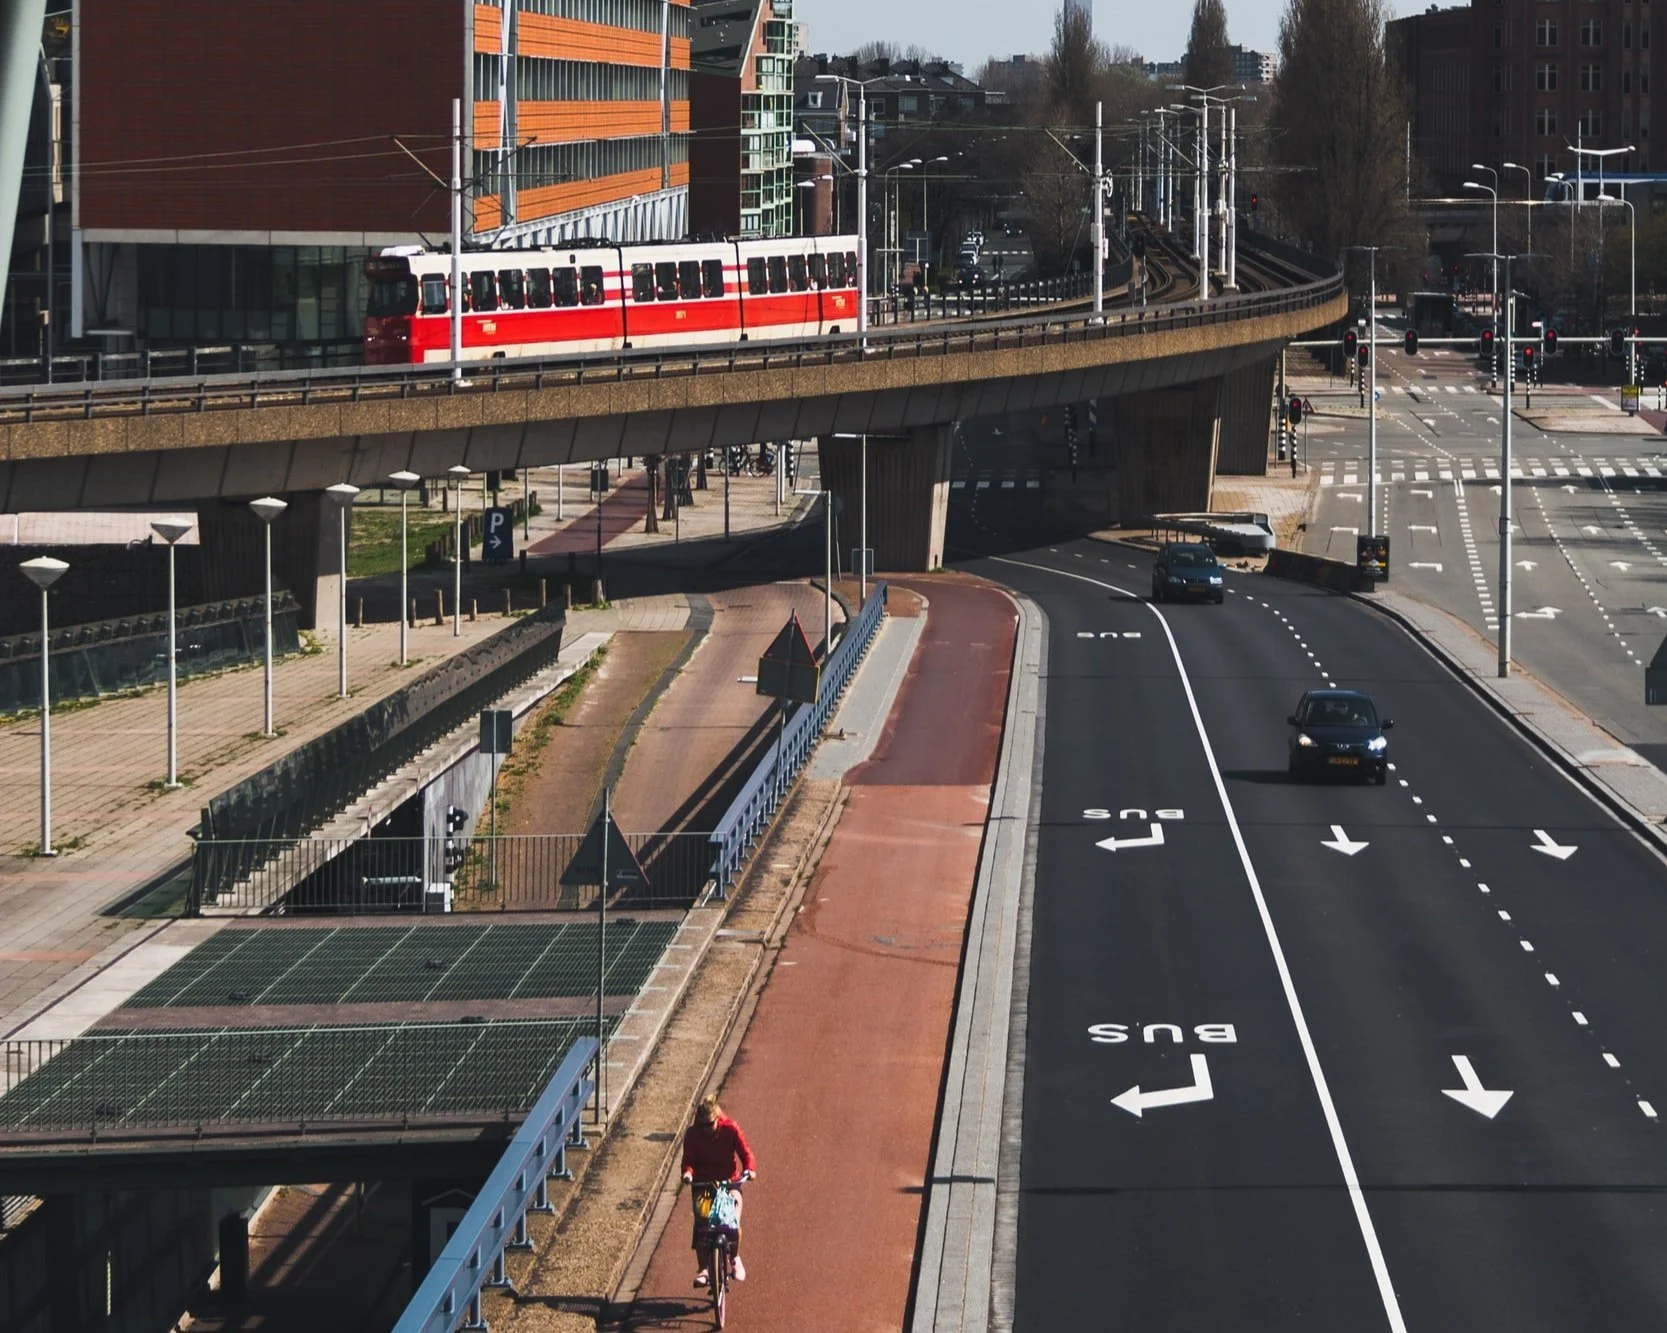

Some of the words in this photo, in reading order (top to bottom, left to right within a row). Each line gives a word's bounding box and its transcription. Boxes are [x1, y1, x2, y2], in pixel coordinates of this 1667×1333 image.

[490, 512, 504, 534] P
[1082, 809, 1184, 819] BUS
[1087, 1023, 1238, 1043] BUS
